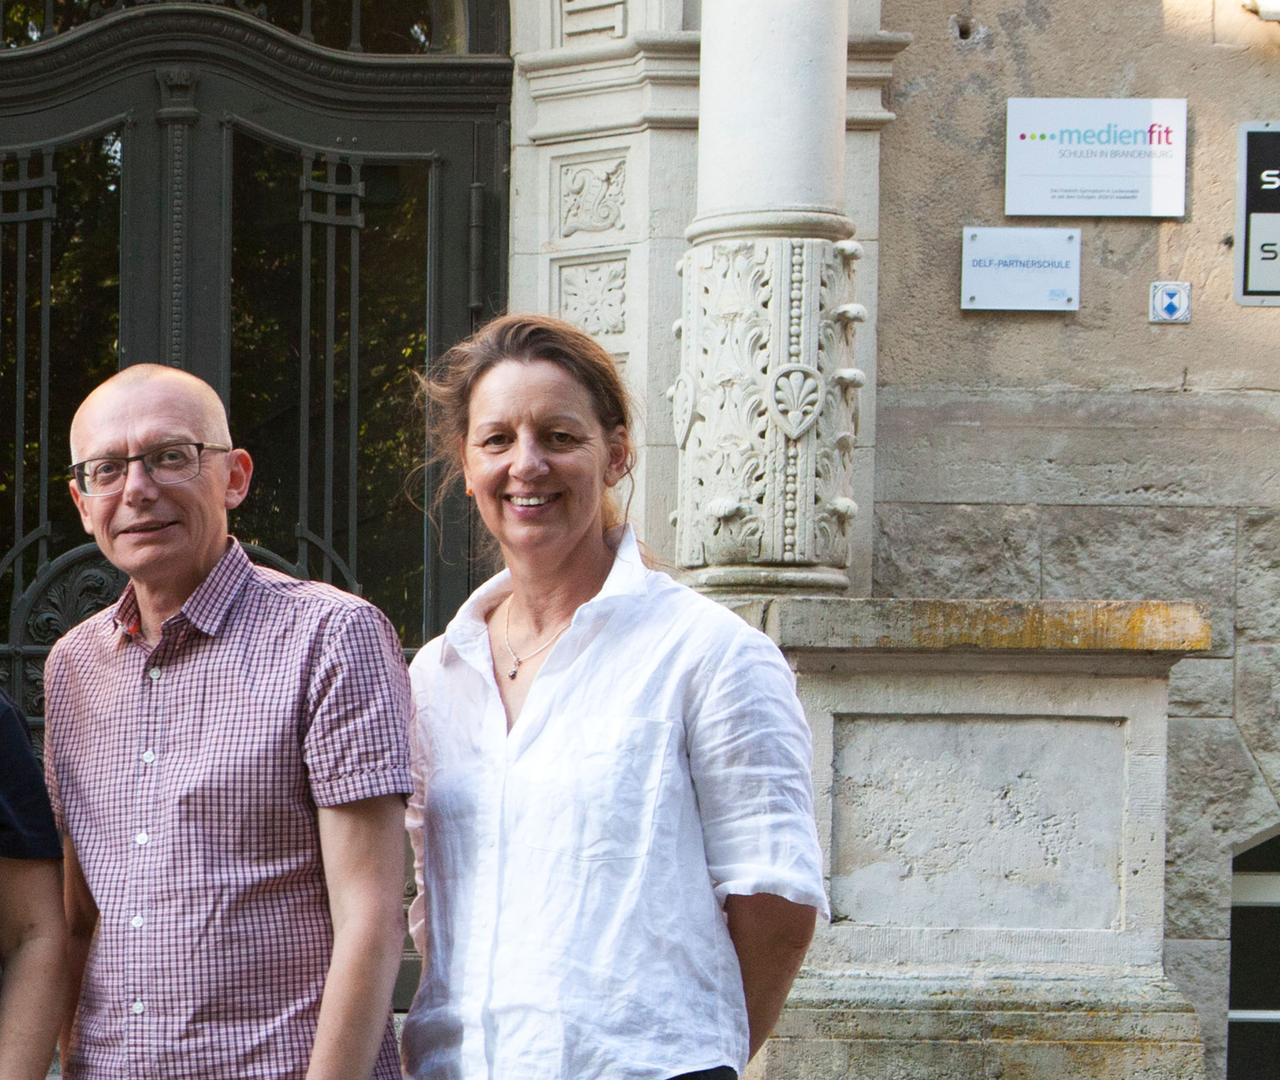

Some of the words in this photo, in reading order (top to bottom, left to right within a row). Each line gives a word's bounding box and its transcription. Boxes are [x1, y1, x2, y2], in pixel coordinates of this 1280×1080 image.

[1059, 122, 1173, 145] medienfit
[1058, 149, 1097, 159] SCHULEN
[1099, 149, 1108, 159] IN
[1110, 149, 1173, 159] BRANDENBURG
[971, 259, 1071, 269] DELF-PARTNERSCHULE
